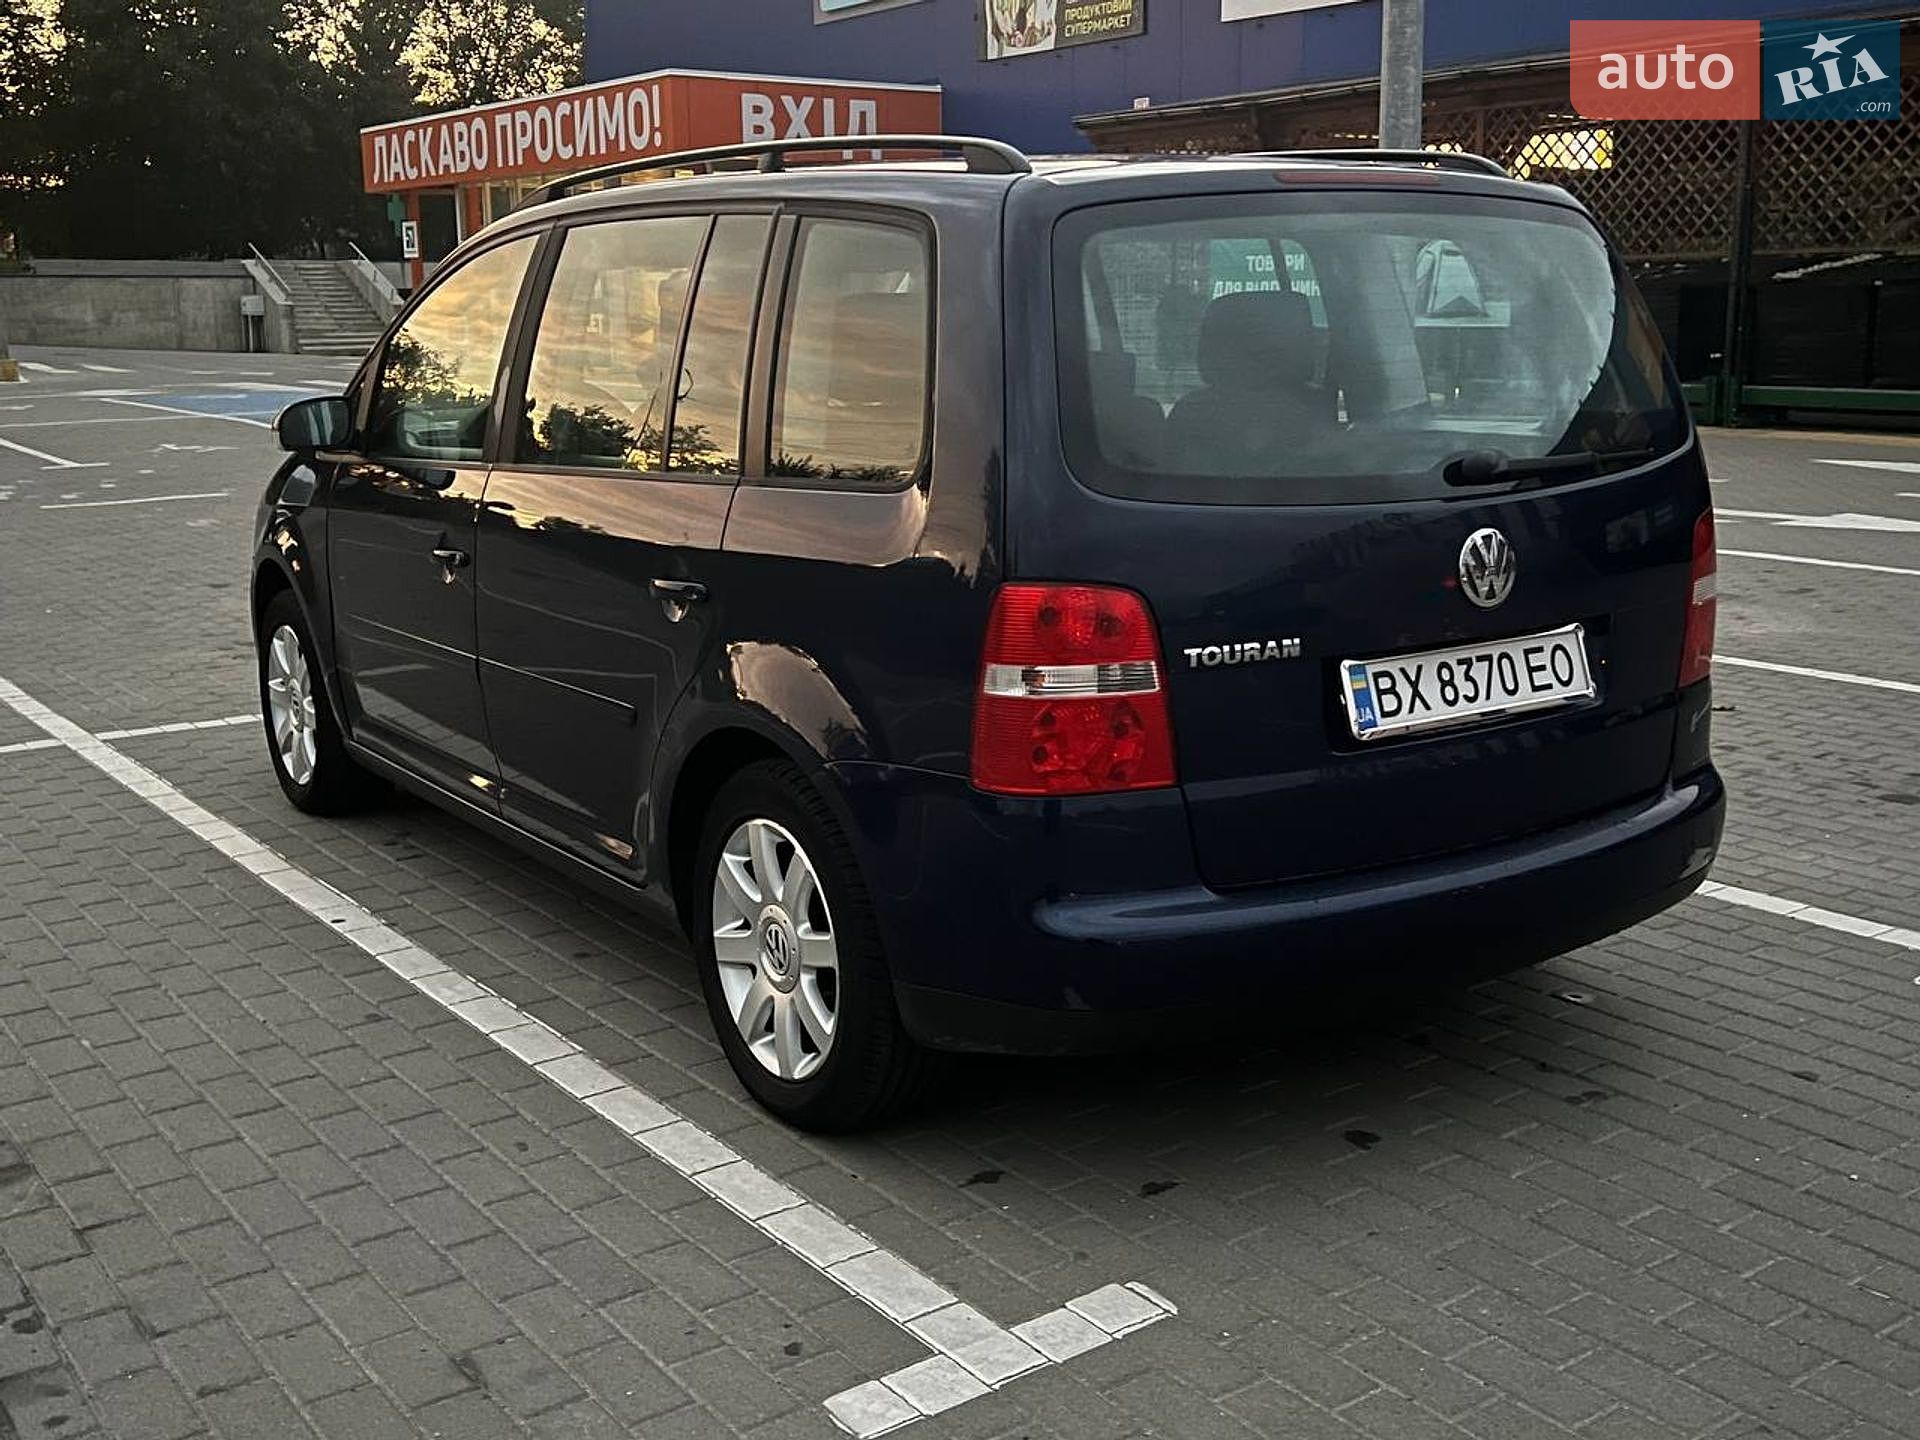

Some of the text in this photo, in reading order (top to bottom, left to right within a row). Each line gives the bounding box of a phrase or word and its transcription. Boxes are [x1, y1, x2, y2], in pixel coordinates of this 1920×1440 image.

[1065, 14, 1132, 37] СУПЕРМАРКЕТ
[373, 84, 661, 184] ЛАСКАВО ПРОСИМО!
[741, 92, 882, 160] ВХІД
[1246, 254, 1305, 272] ТОВРИ
[1184, 638, 1300, 668] TOURAN
[1372, 644, 1574, 718] BX 8370 EO
[1357, 706, 1375, 722] UA
